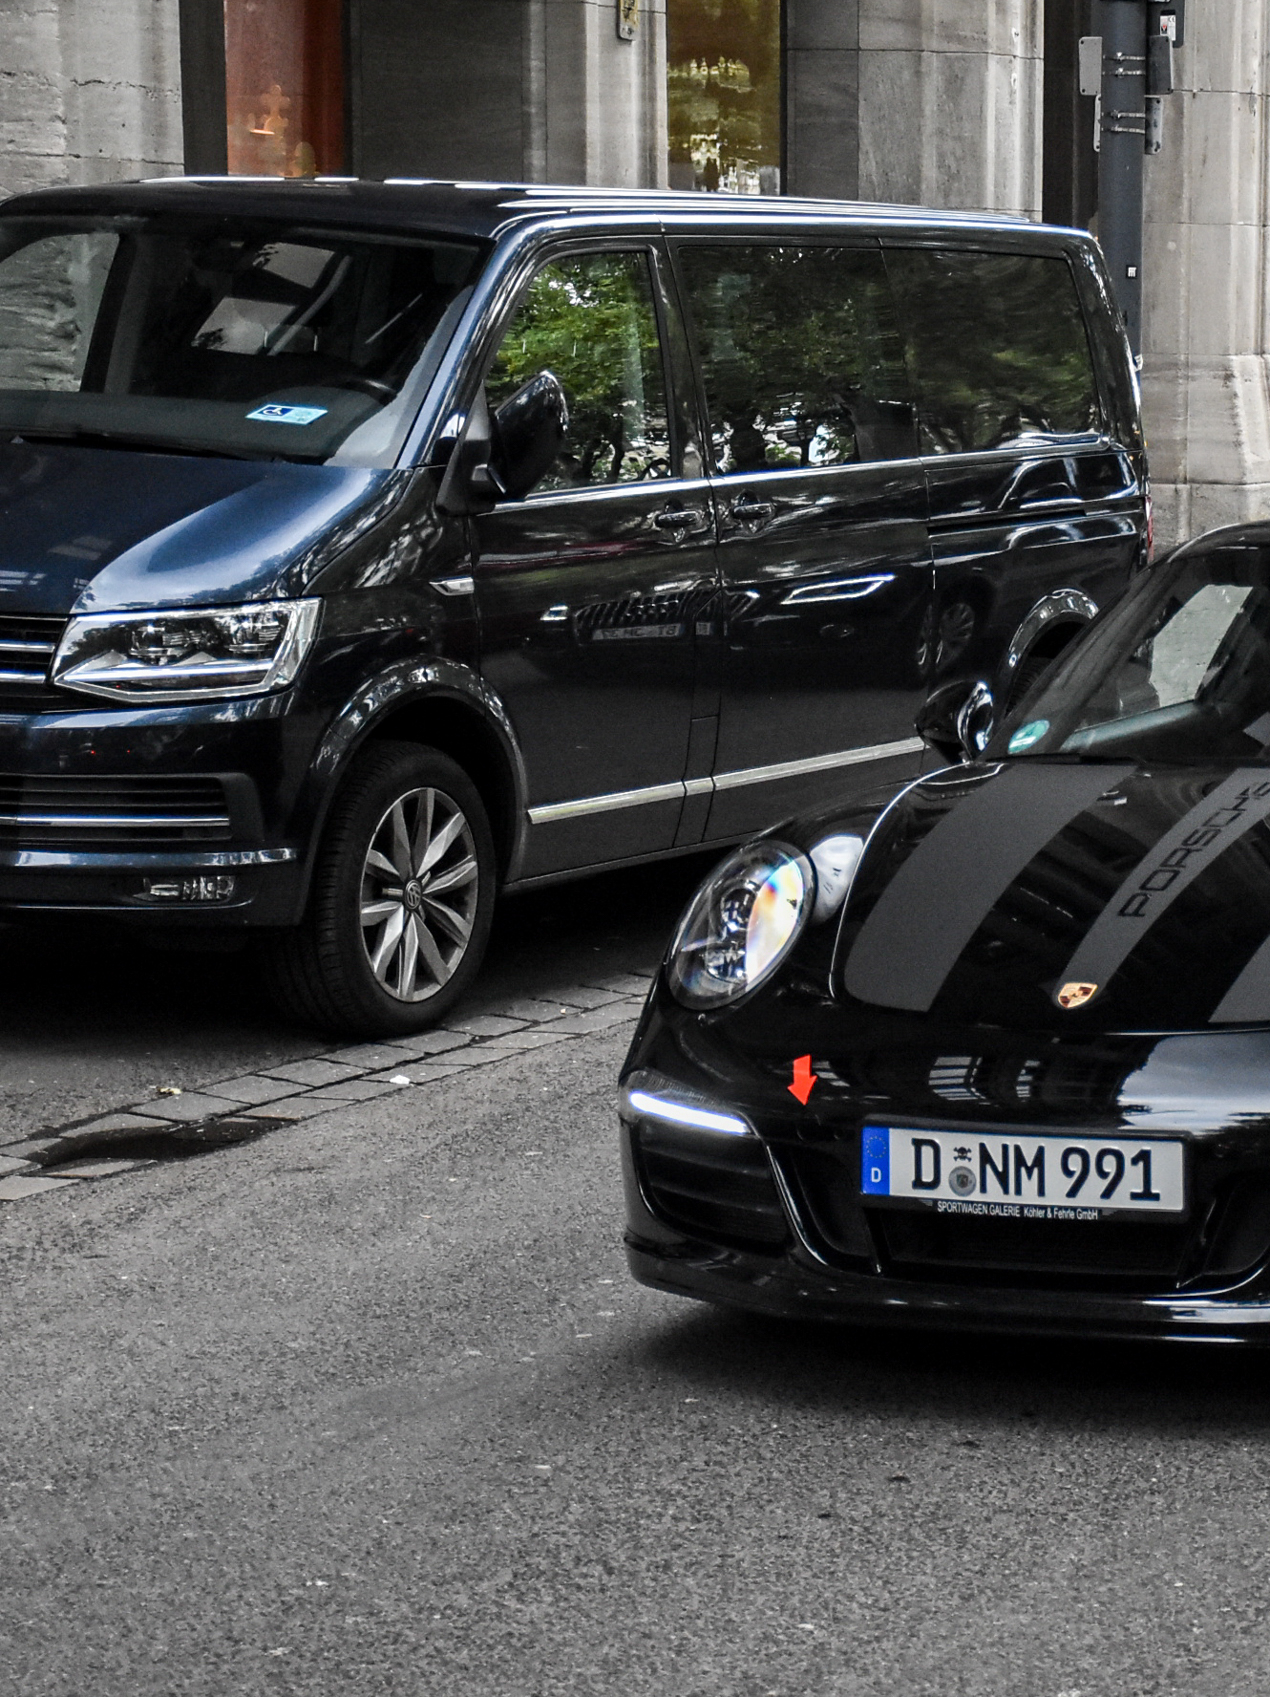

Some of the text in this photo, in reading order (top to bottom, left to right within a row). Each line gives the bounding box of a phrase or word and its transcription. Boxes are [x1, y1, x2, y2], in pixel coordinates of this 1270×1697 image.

[870, 1167, 882, 1184] D
[912, 1137, 1162, 1203] D NM 991
[937, 1200, 1099, 1221] SPORTWAGEN GALERIE Köhler & Fehrle GmbH
